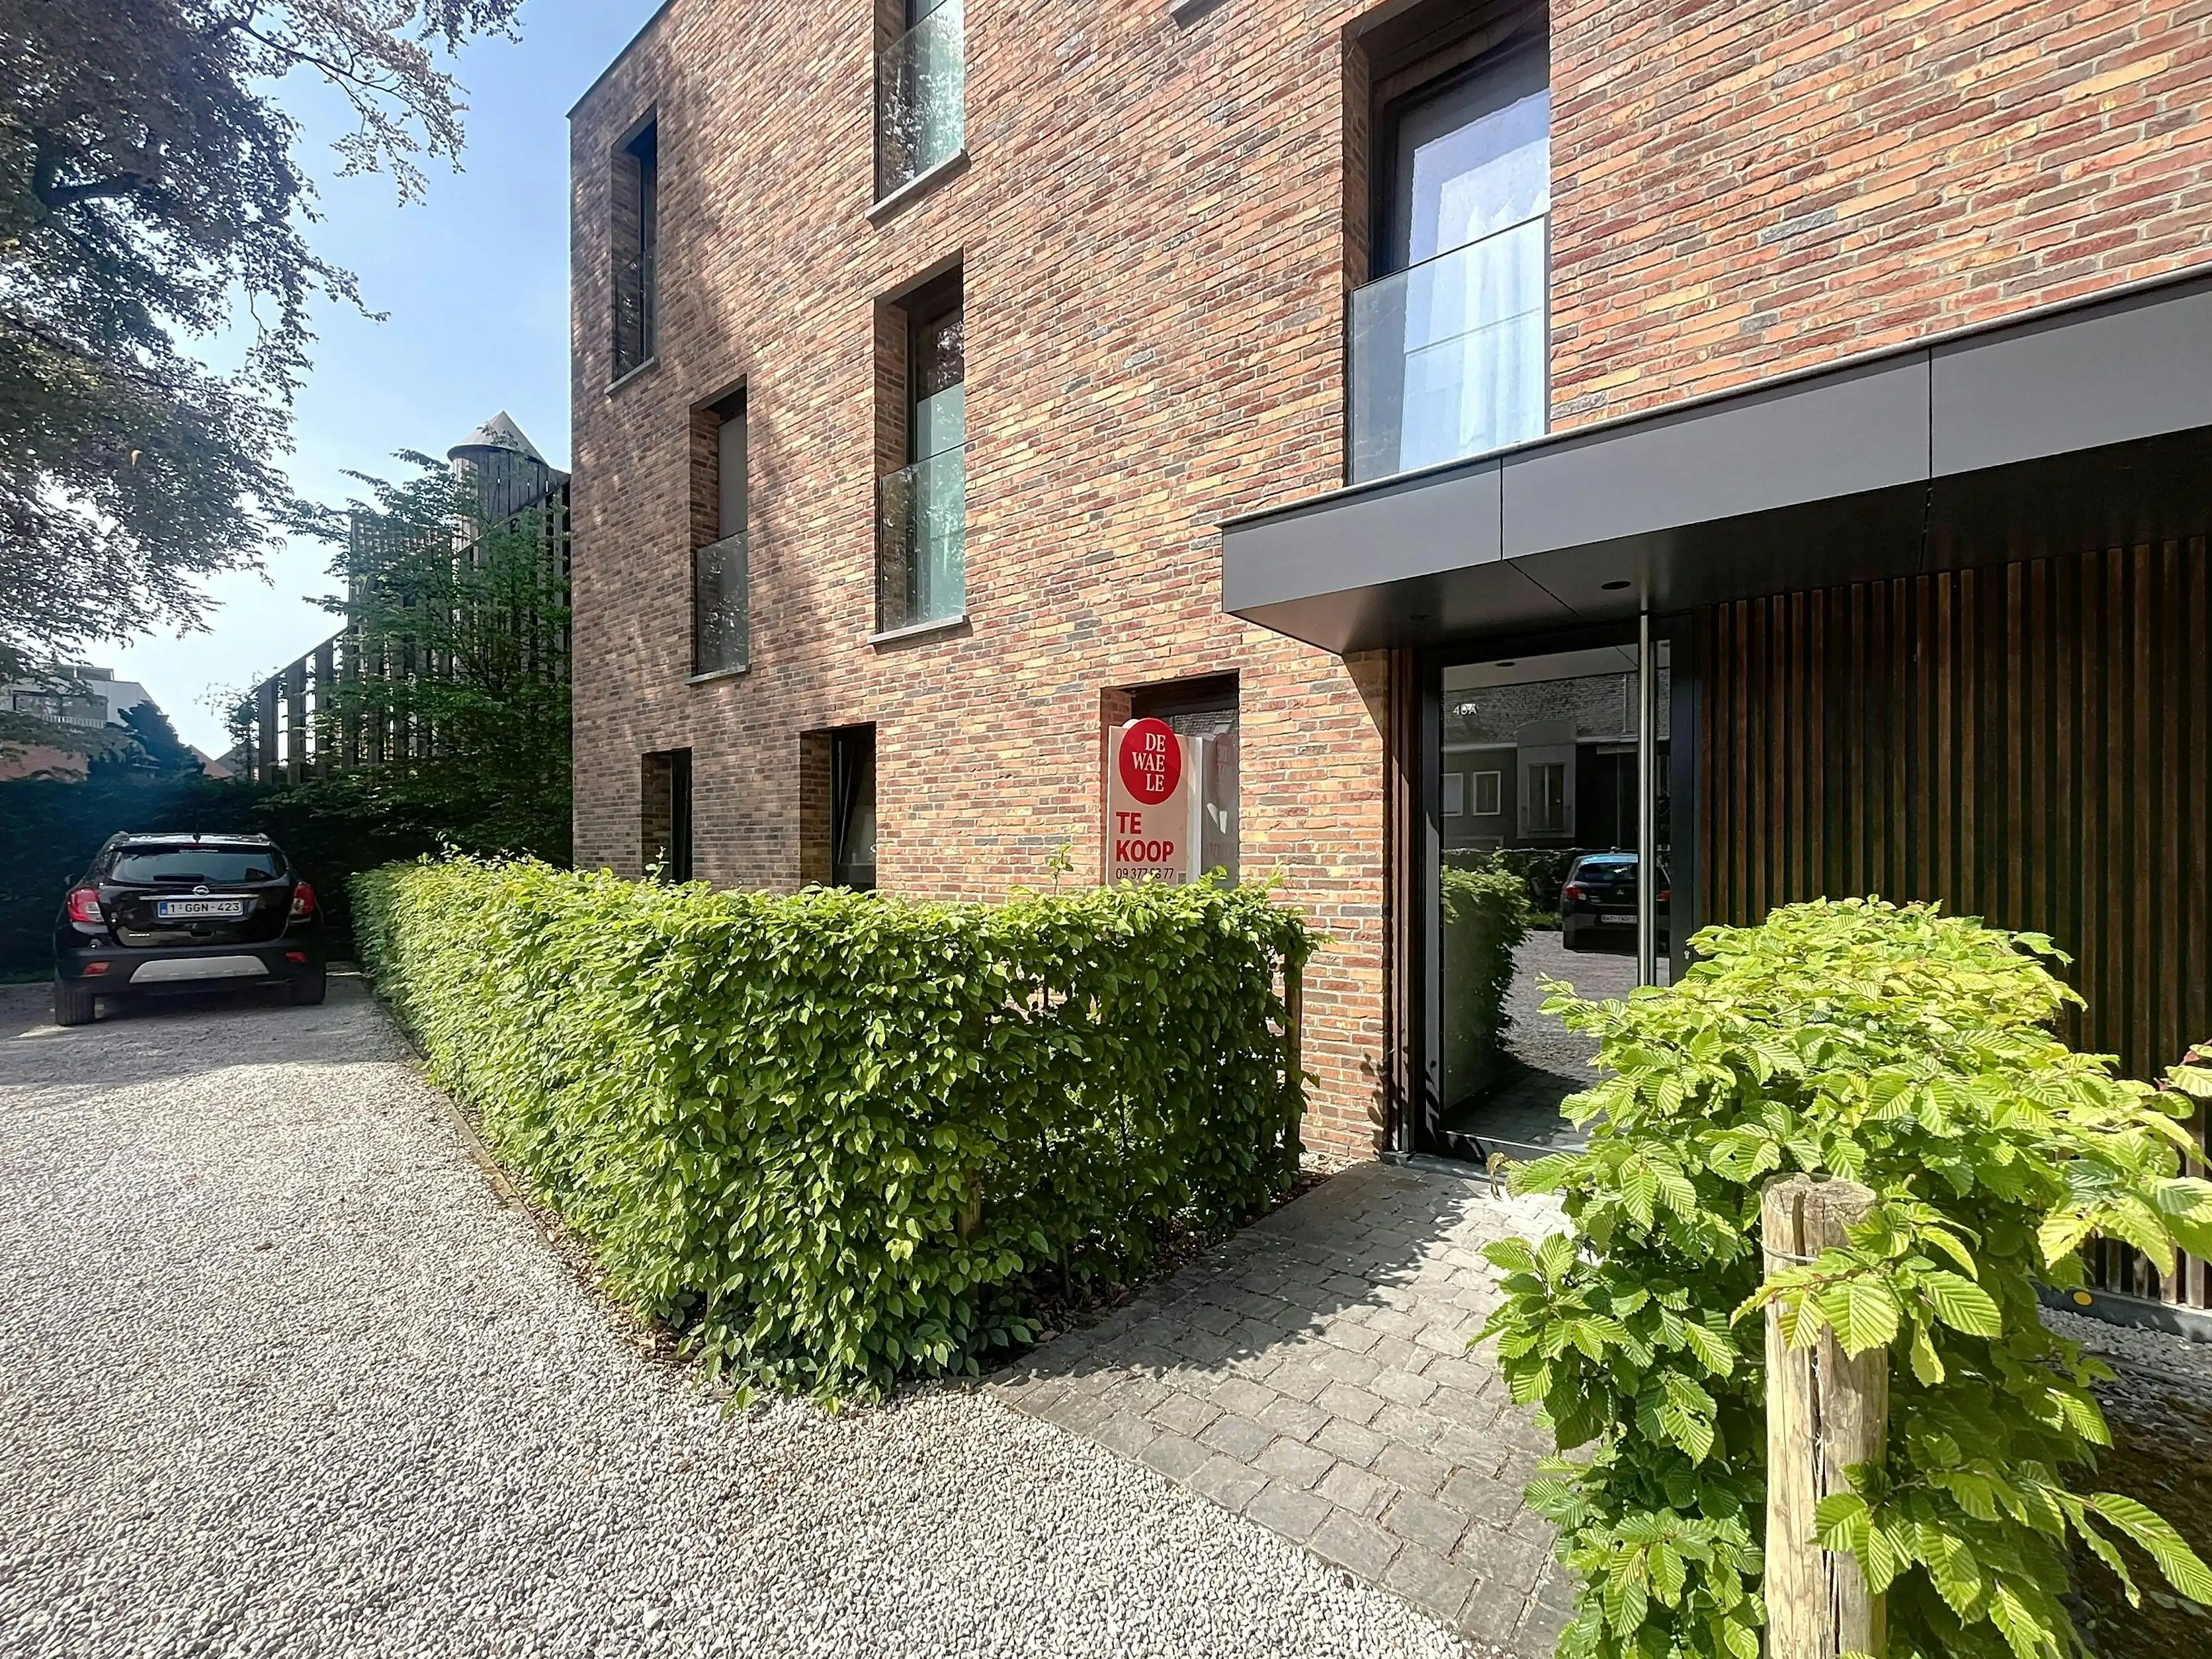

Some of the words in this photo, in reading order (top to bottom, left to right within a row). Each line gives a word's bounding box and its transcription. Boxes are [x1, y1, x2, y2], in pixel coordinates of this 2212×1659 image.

[1145, 732, 1166, 752] DE
[1132, 751, 1165, 772] WAE
[1146, 773, 1164, 792] LE
[1115, 812, 1142, 834] TE
[1115, 839, 1174, 862] KOOP
[1116, 868, 1128, 879] 09
[1164, 868, 1174, 879] 77
